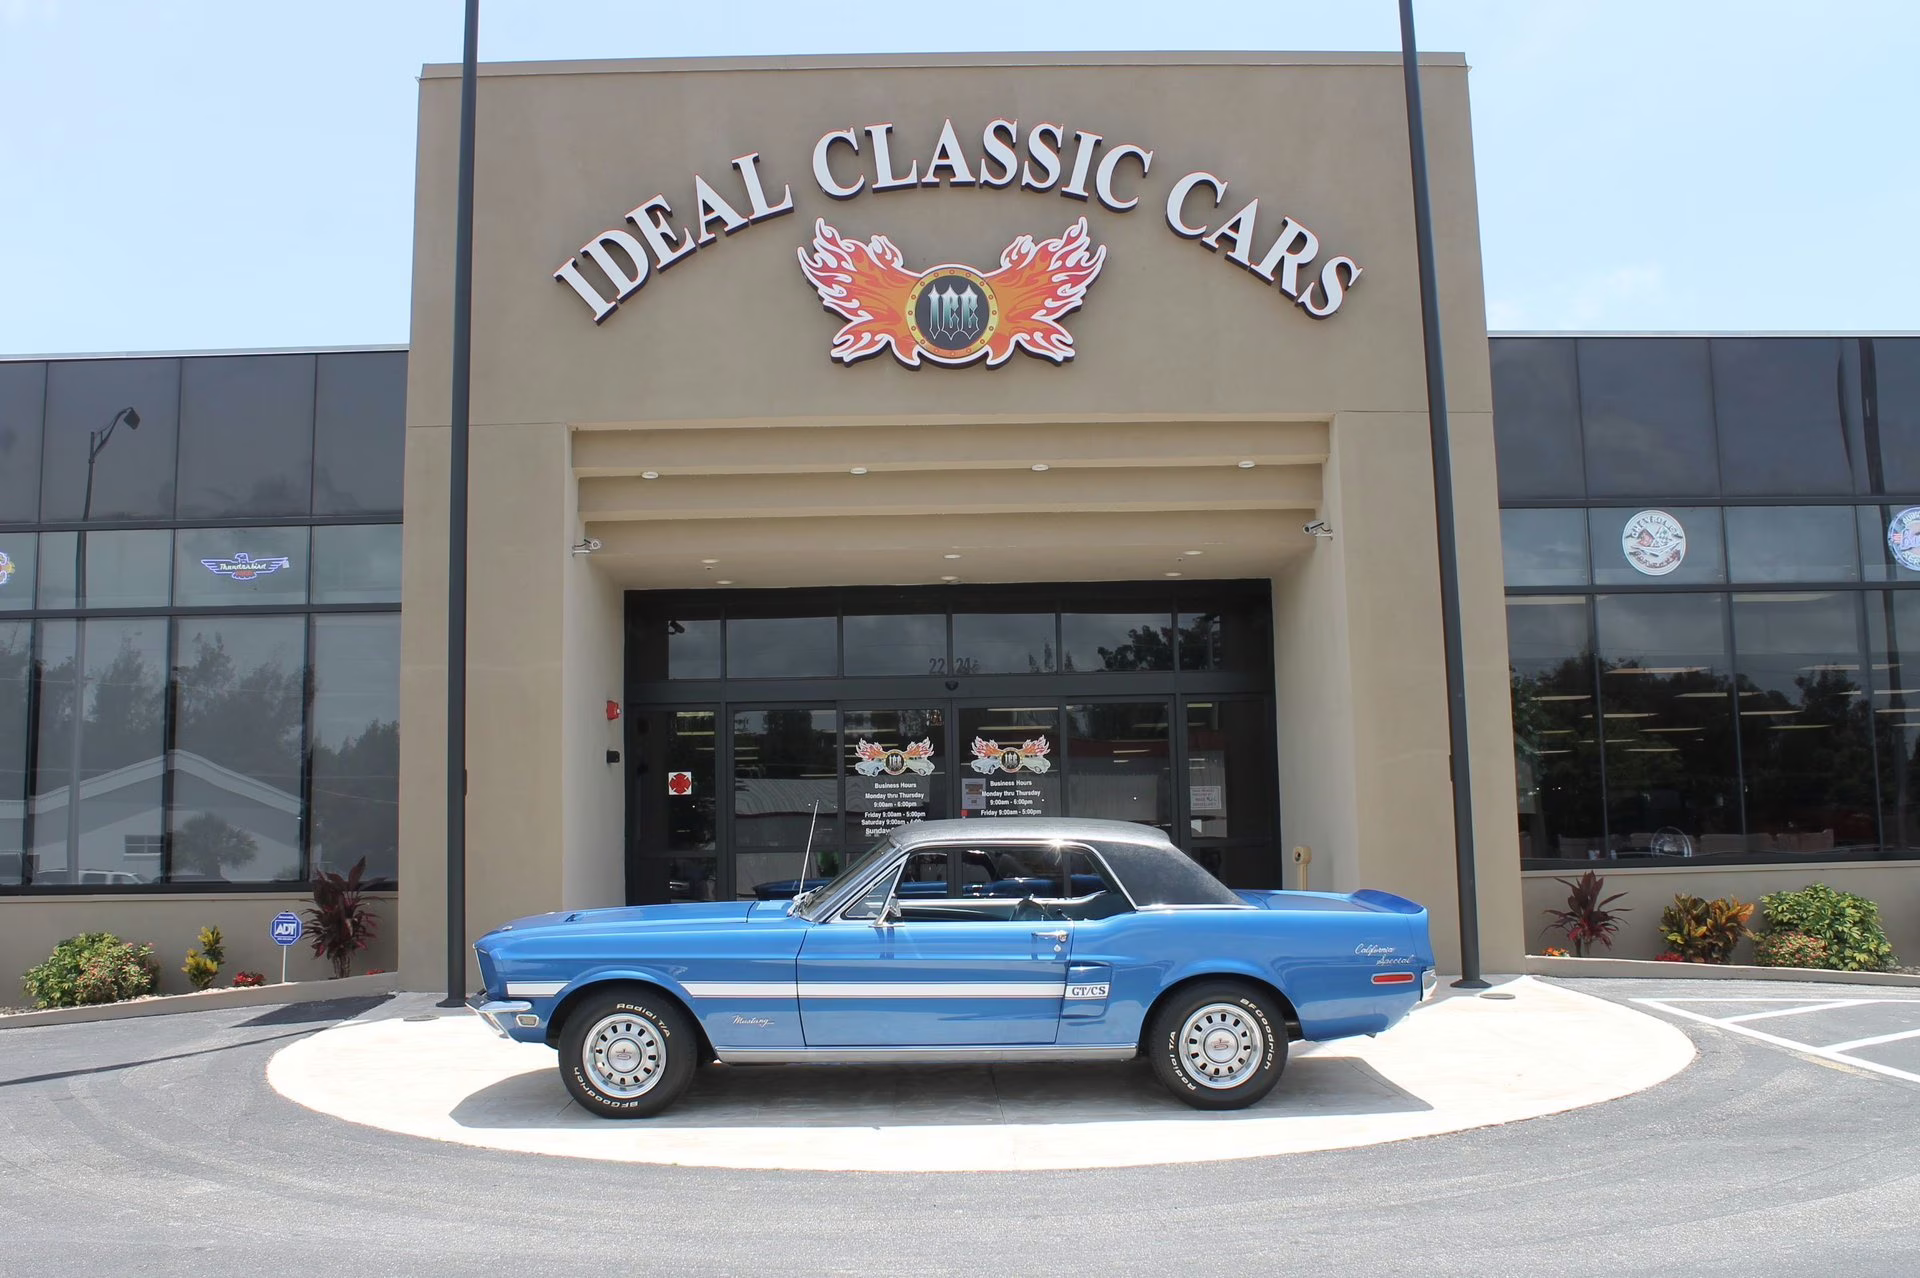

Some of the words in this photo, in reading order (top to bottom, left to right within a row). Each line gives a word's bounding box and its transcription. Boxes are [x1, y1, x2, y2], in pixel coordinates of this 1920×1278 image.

[553, 152, 794, 326] IDEAL
[812, 117, 1154, 214] CLASSIC
[1165, 171, 1363, 321] CARS
[865, 827, 891, 835] Sunday
[275, 923, 296, 935] ADT
[1354, 943, 1394, 957] California
[1072, 986, 1106, 996] GT/CS
[616, 1003, 657, 1020] Radial
[732, 1015, 775, 1028] Mustang
[1240, 998, 1275, 1070] BFGoodrich
[1169, 1054, 1197, 1091] Radial
[573, 1066, 639, 1108] BFGoodrich
